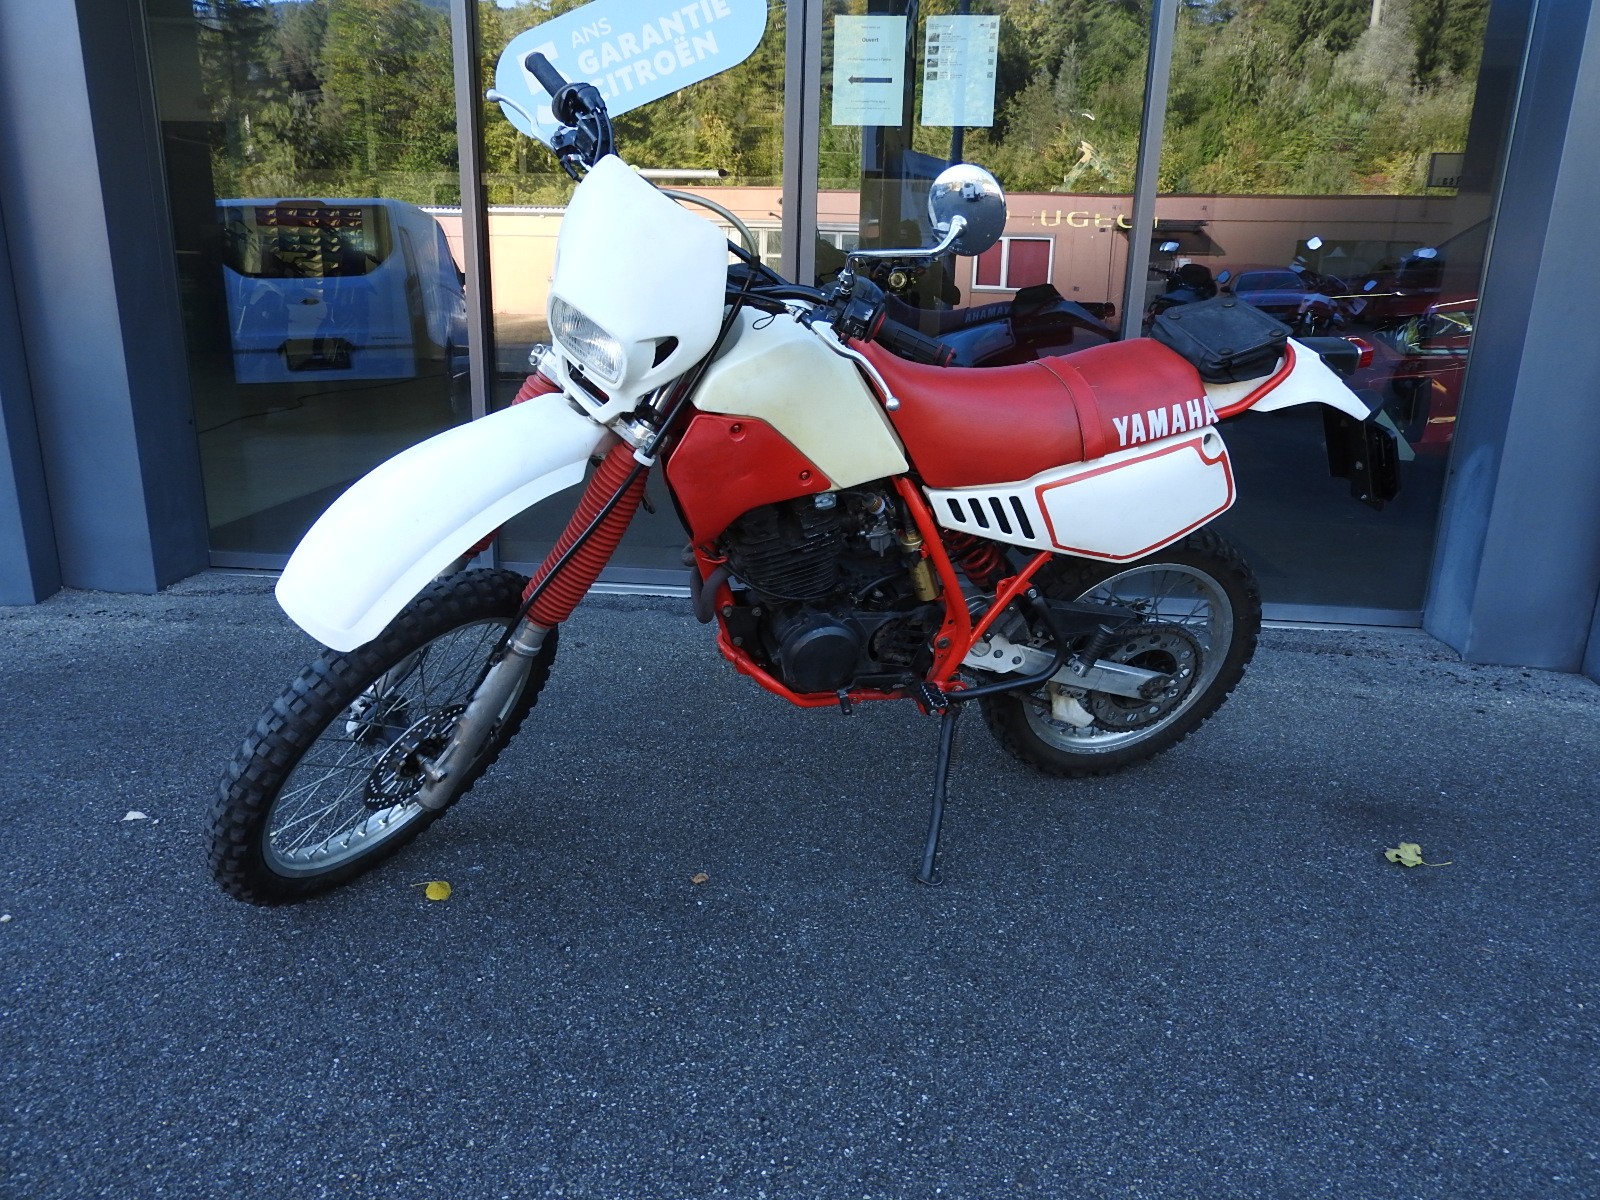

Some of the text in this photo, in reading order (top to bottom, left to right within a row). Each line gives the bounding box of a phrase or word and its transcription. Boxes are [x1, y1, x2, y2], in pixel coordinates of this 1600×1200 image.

[571, 17, 612, 49] ANS
[577, 0, 731, 75] GARANTIE
[1112, 395, 1219, 447] YAMAHA
